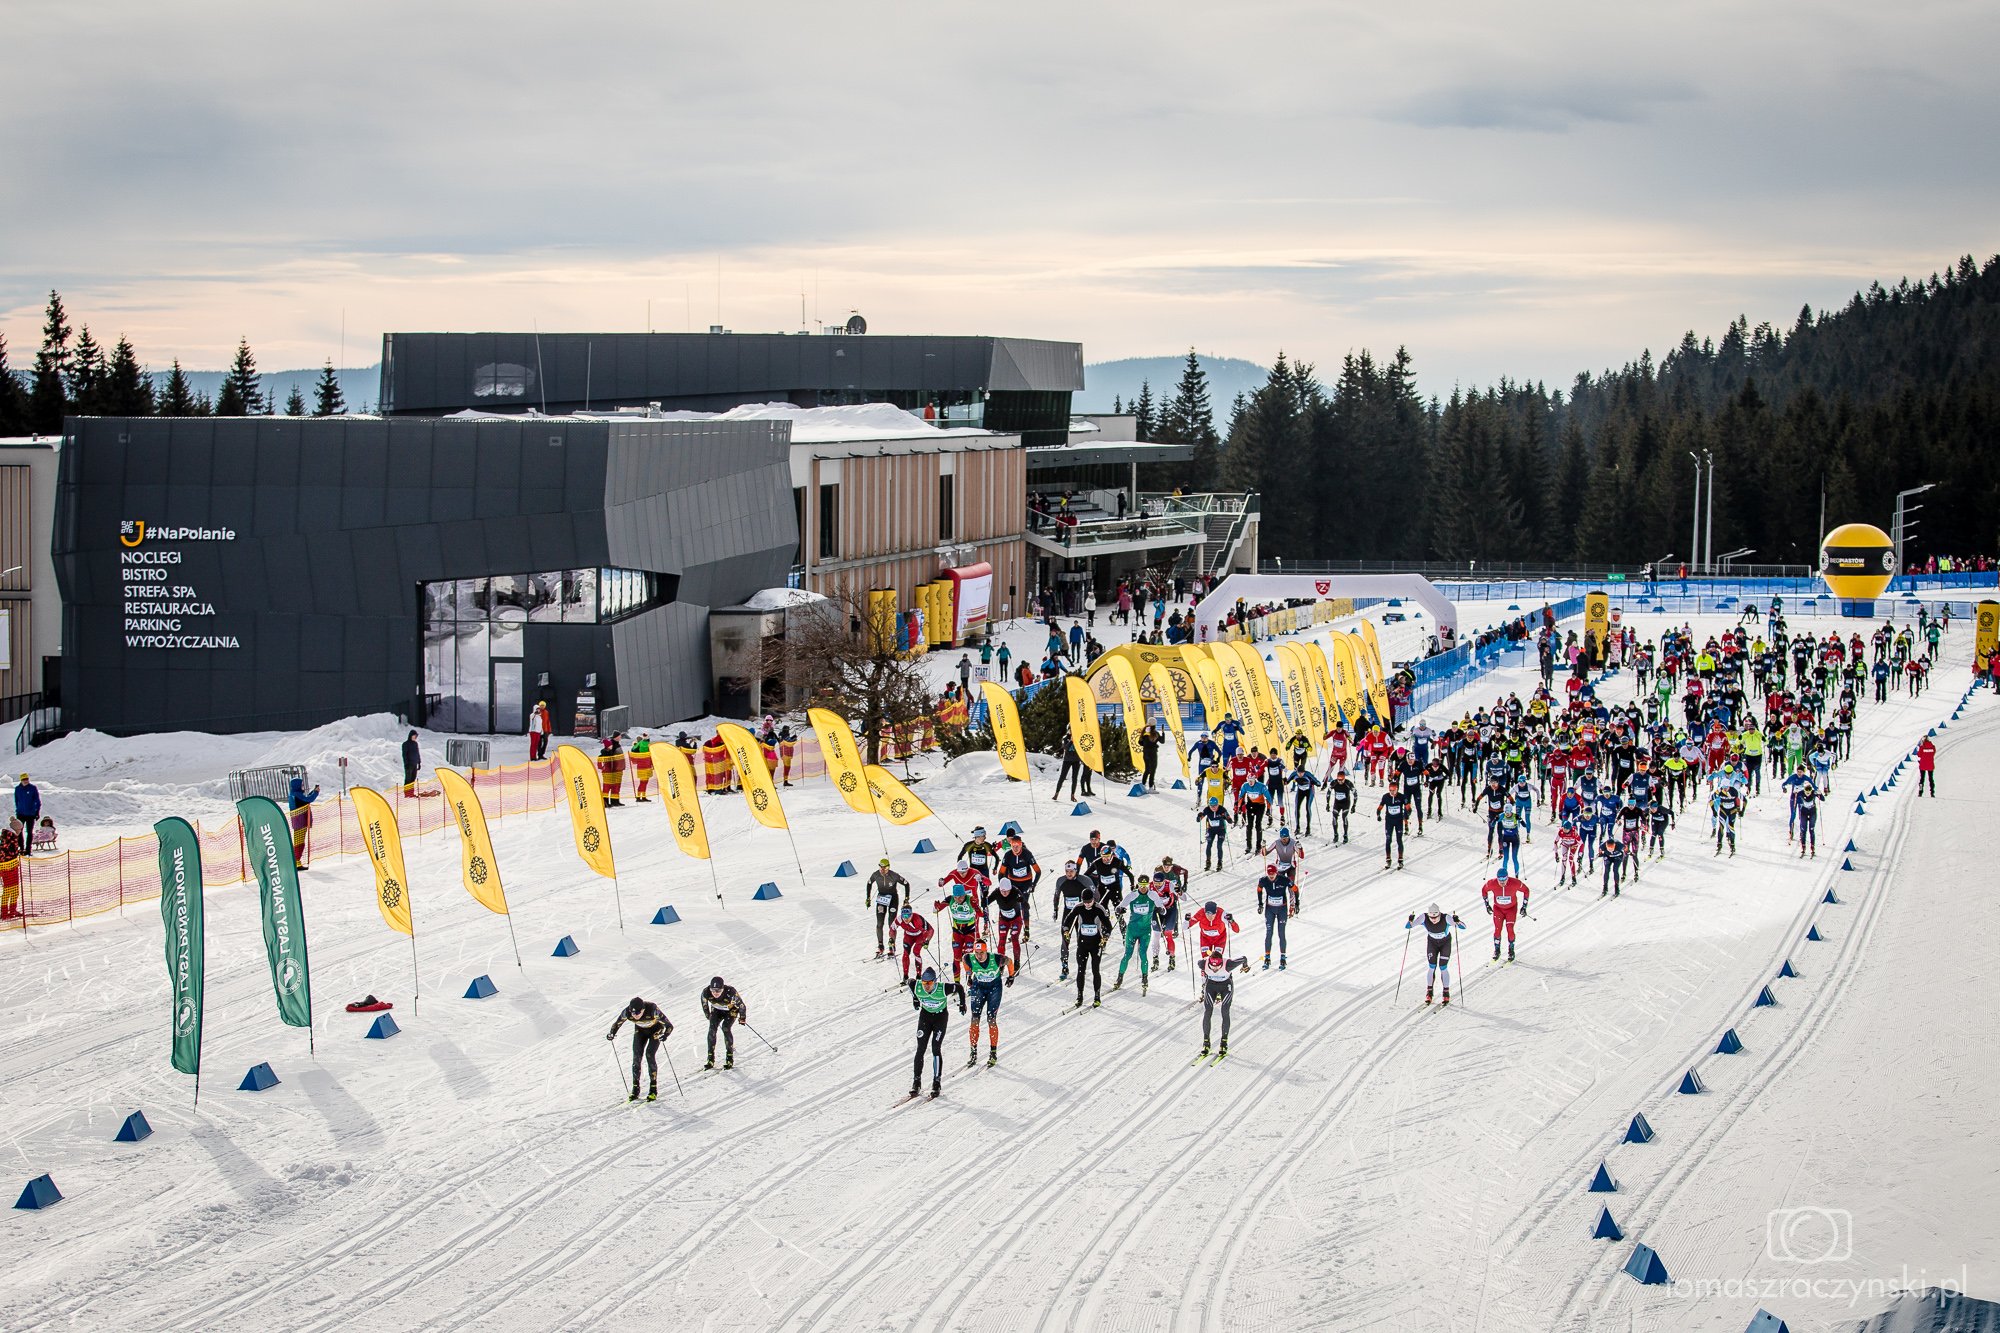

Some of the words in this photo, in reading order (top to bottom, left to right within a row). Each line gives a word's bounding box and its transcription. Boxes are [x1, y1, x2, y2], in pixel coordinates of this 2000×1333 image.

[146, 527, 236, 541] #NaPolanie
[121, 552, 182, 564] NOCLEGI
[122, 568, 167, 581] BISTRO
[124, 585, 169, 598] STREFA
[172, 586, 196, 598] SPA
[124, 602, 216, 615] RESTAURACJA
[124, 618, 182, 631] PARKING
[125, 633, 240, 648] WYPOŻYCZALNIA
[974, 666, 988, 677] START
